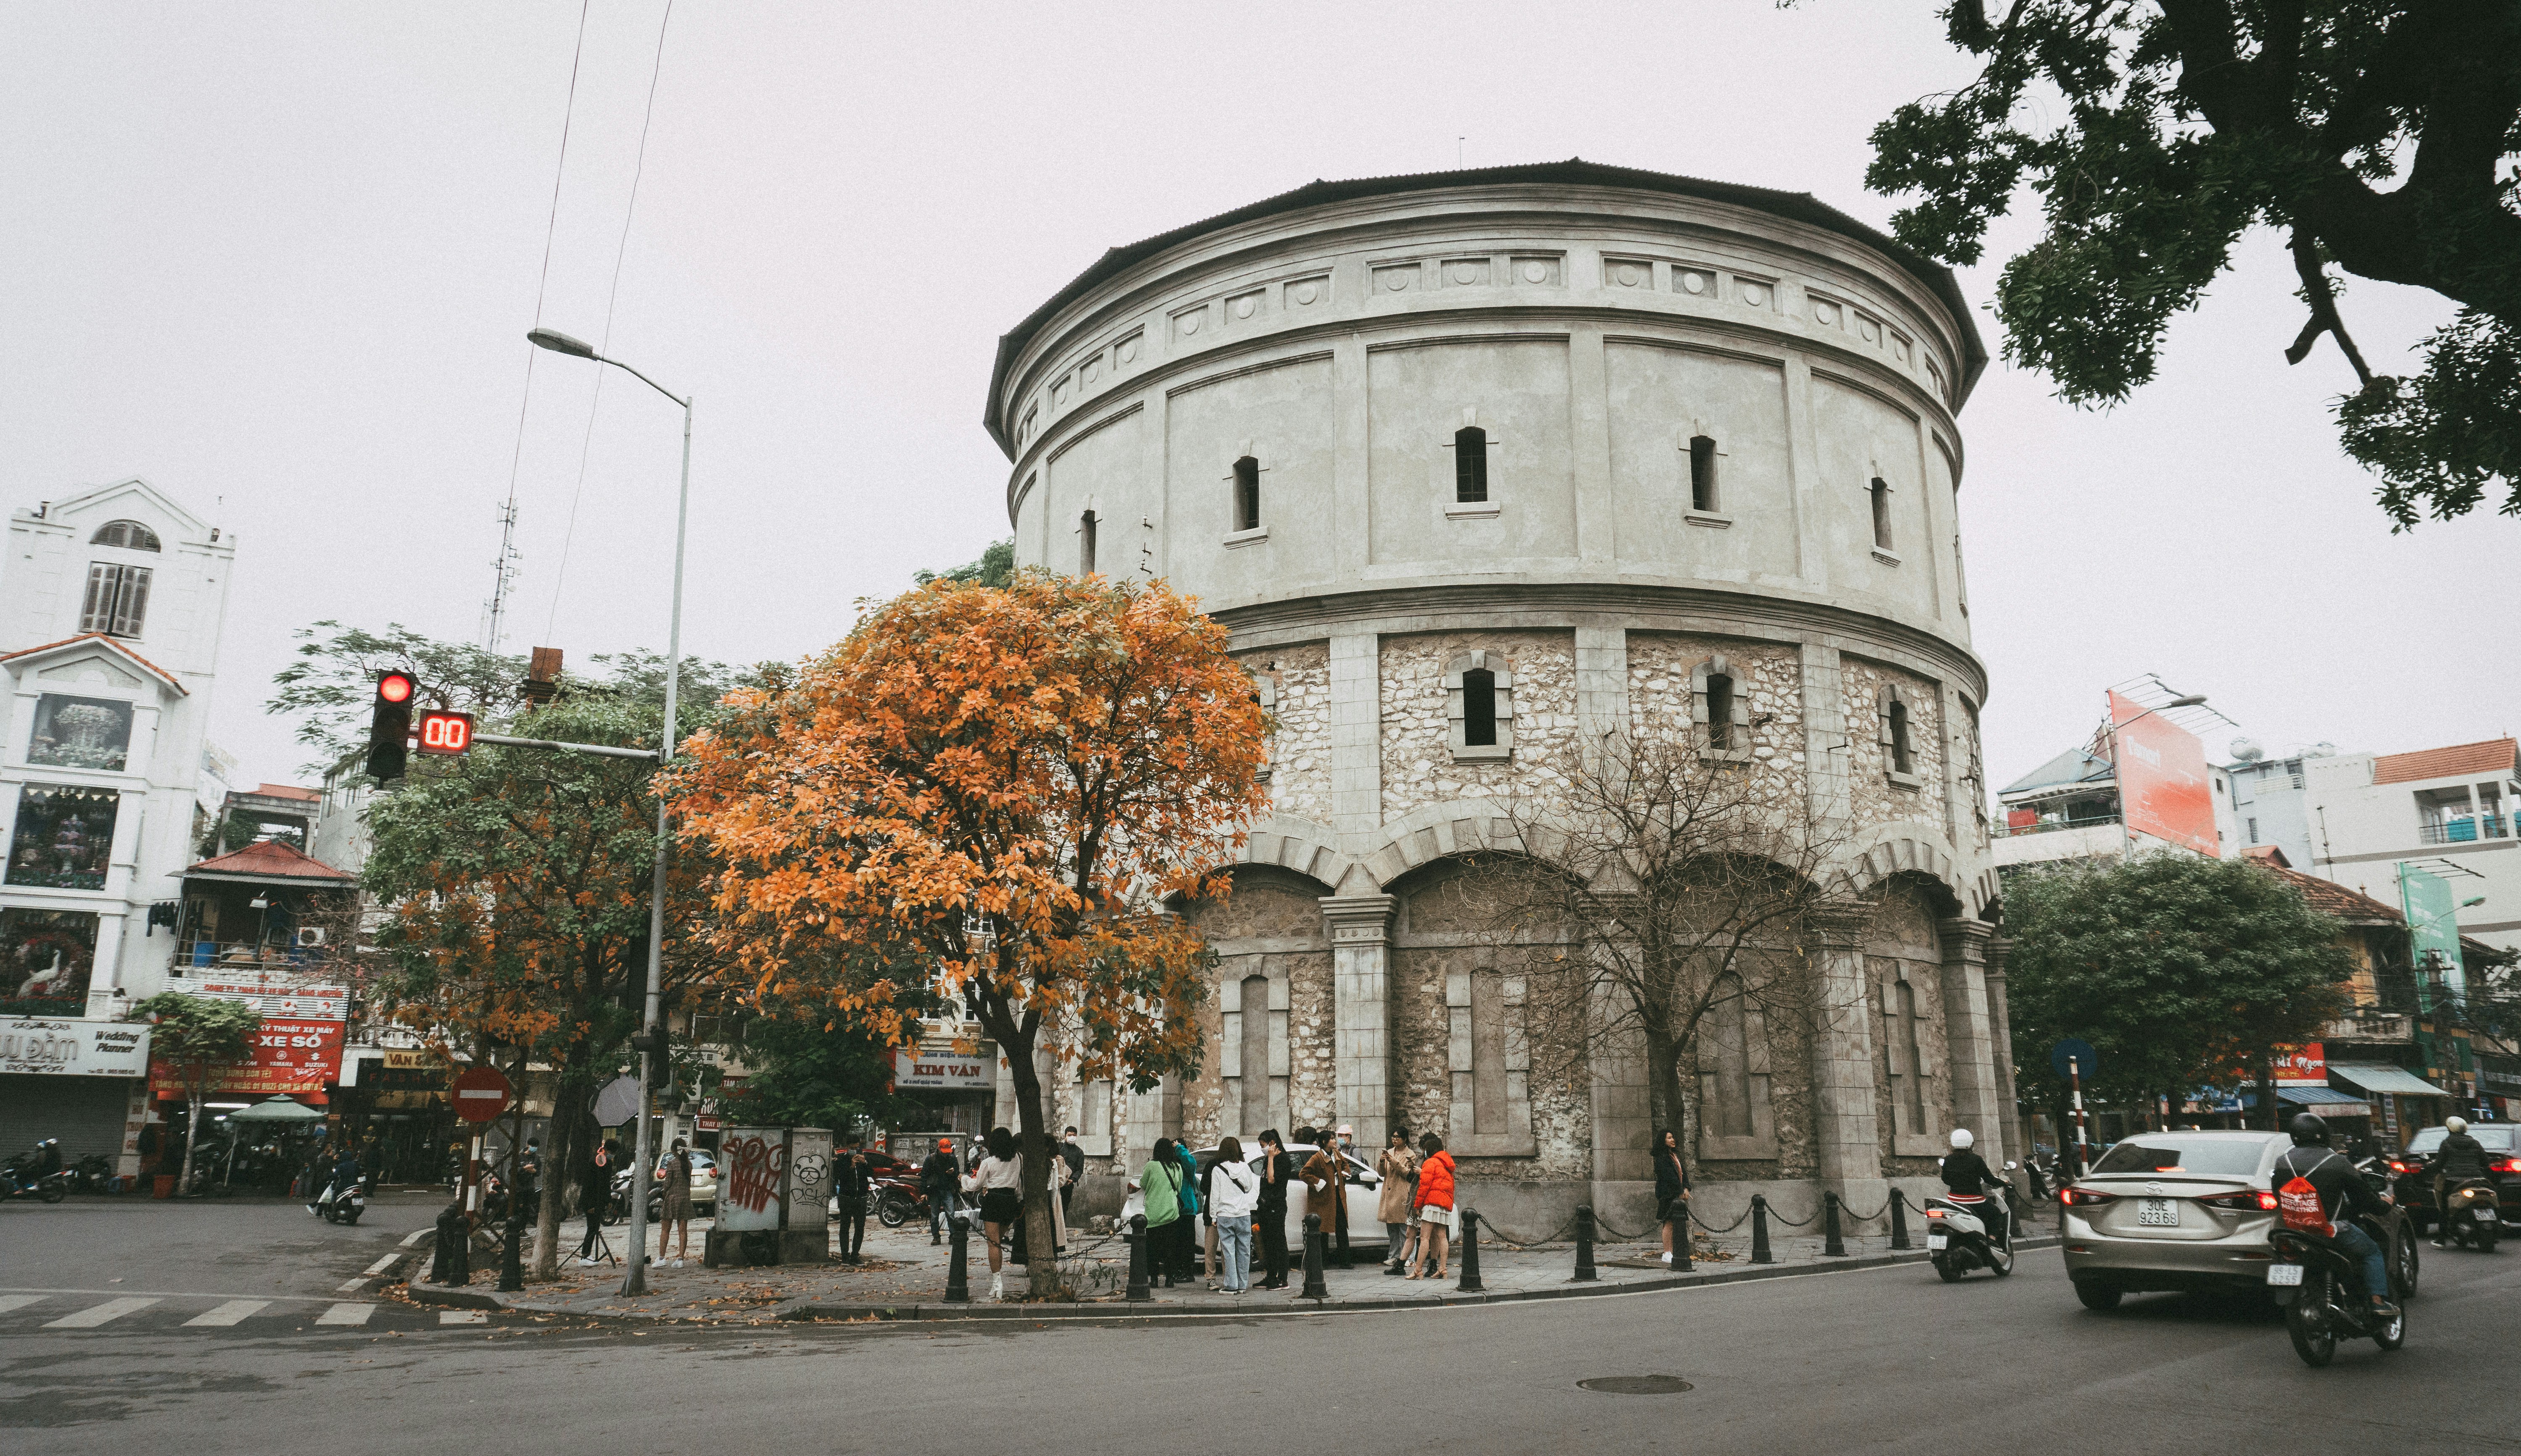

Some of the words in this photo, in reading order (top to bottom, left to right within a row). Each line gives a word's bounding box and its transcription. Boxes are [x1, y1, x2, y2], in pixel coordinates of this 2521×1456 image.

[425, 718, 464, 748] 00
[95, 1031, 140, 1043] Wedding
[259, 1035, 287, 1047] XE
[292, 1033, 321, 1048] SỐ
[96, 1043, 135, 1053] Planner
[913, 1064, 945, 1076] KIM
[2296, 1057, 2324, 1074] Ngon
[2147, 1199, 2168, 1212] 30E
[2282, 1204, 2319, 1213] MARATHON
[2140, 1212, 2176, 1224] 923.68
